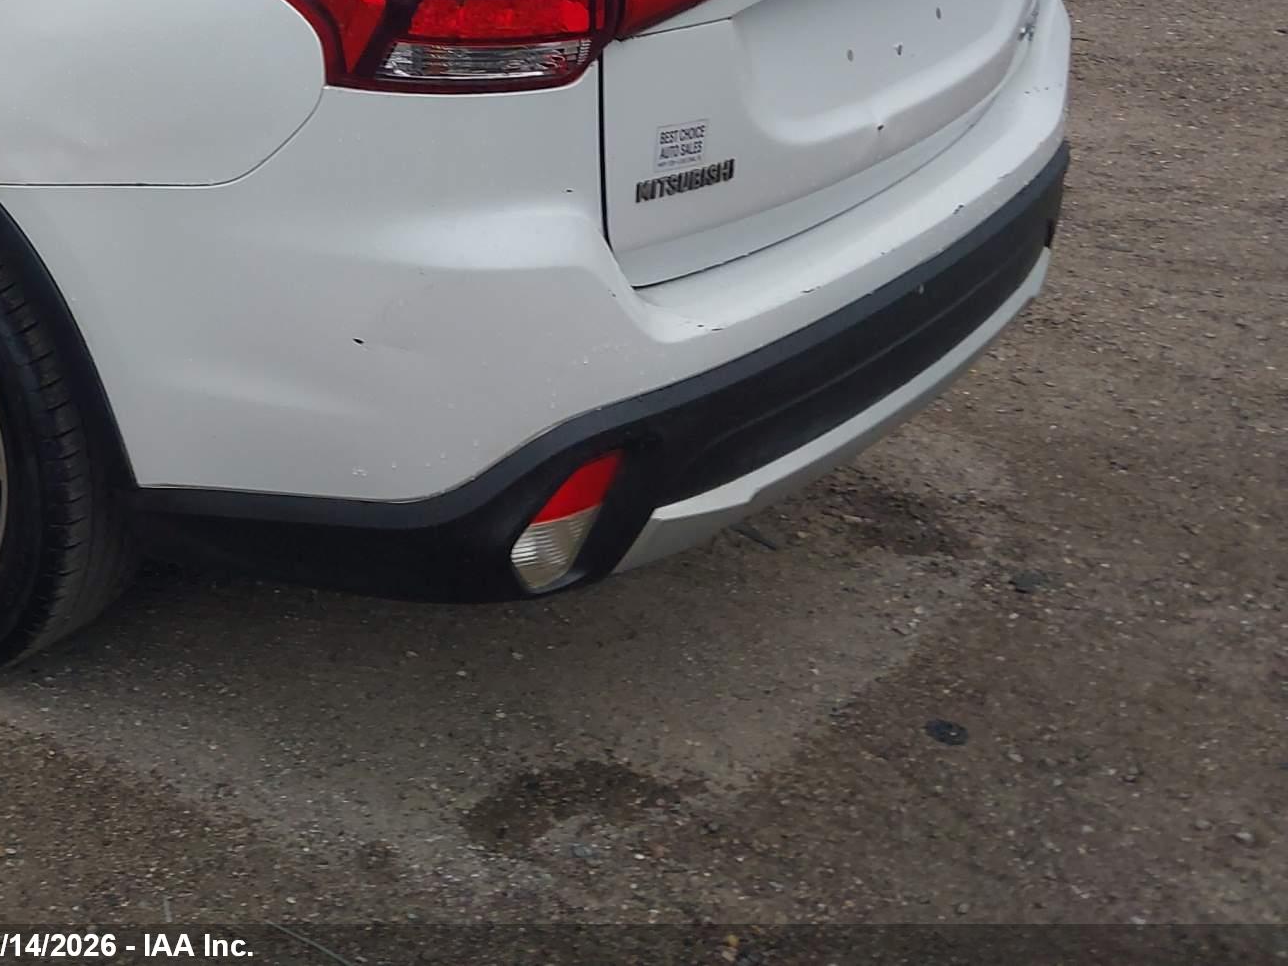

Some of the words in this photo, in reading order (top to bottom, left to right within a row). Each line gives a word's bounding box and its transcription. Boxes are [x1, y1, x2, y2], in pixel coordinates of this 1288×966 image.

[659, 130, 679, 145] BEST
[679, 125, 705, 142] CHOICE
[659, 144, 679, 159] AUTO
[680, 141, 703, 156] SALES
[635, 158, 735, 203] MITSUBISHI
